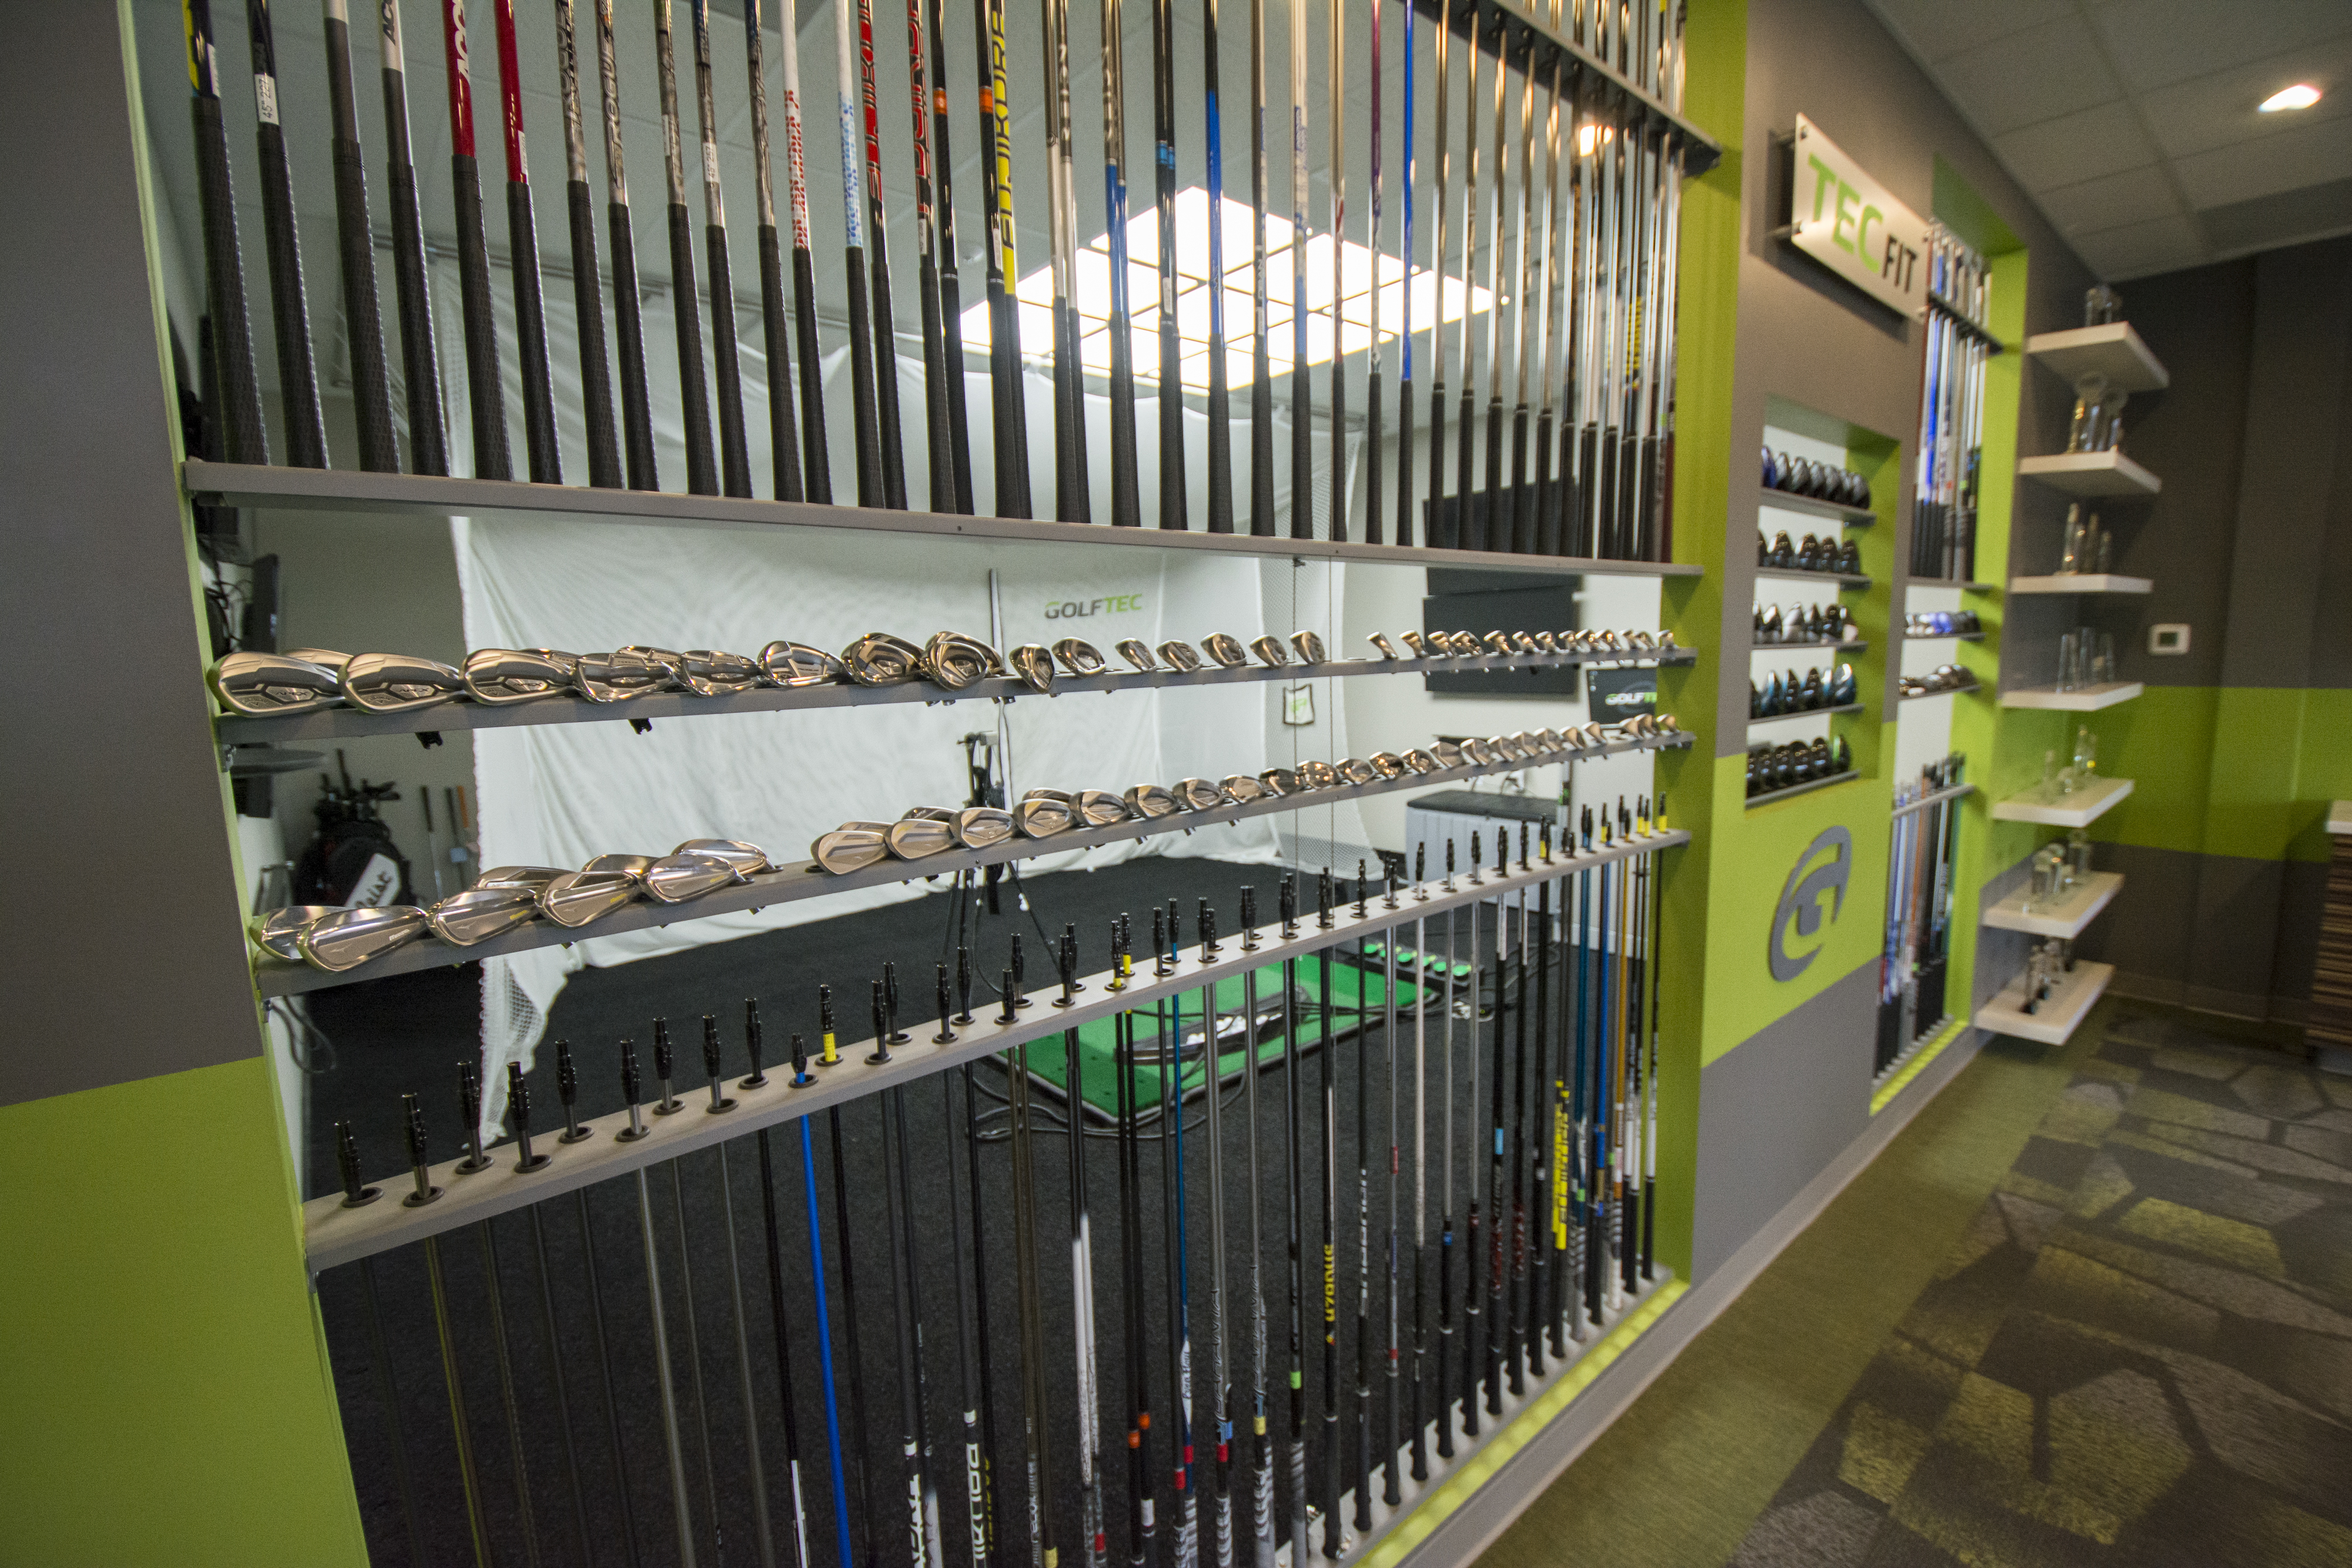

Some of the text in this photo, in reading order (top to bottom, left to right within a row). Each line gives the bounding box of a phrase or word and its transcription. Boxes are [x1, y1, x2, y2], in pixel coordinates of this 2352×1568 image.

[1808, 153, 1918, 293] TEC FIT
[1044, 594, 1142, 619] GOLFTEC
